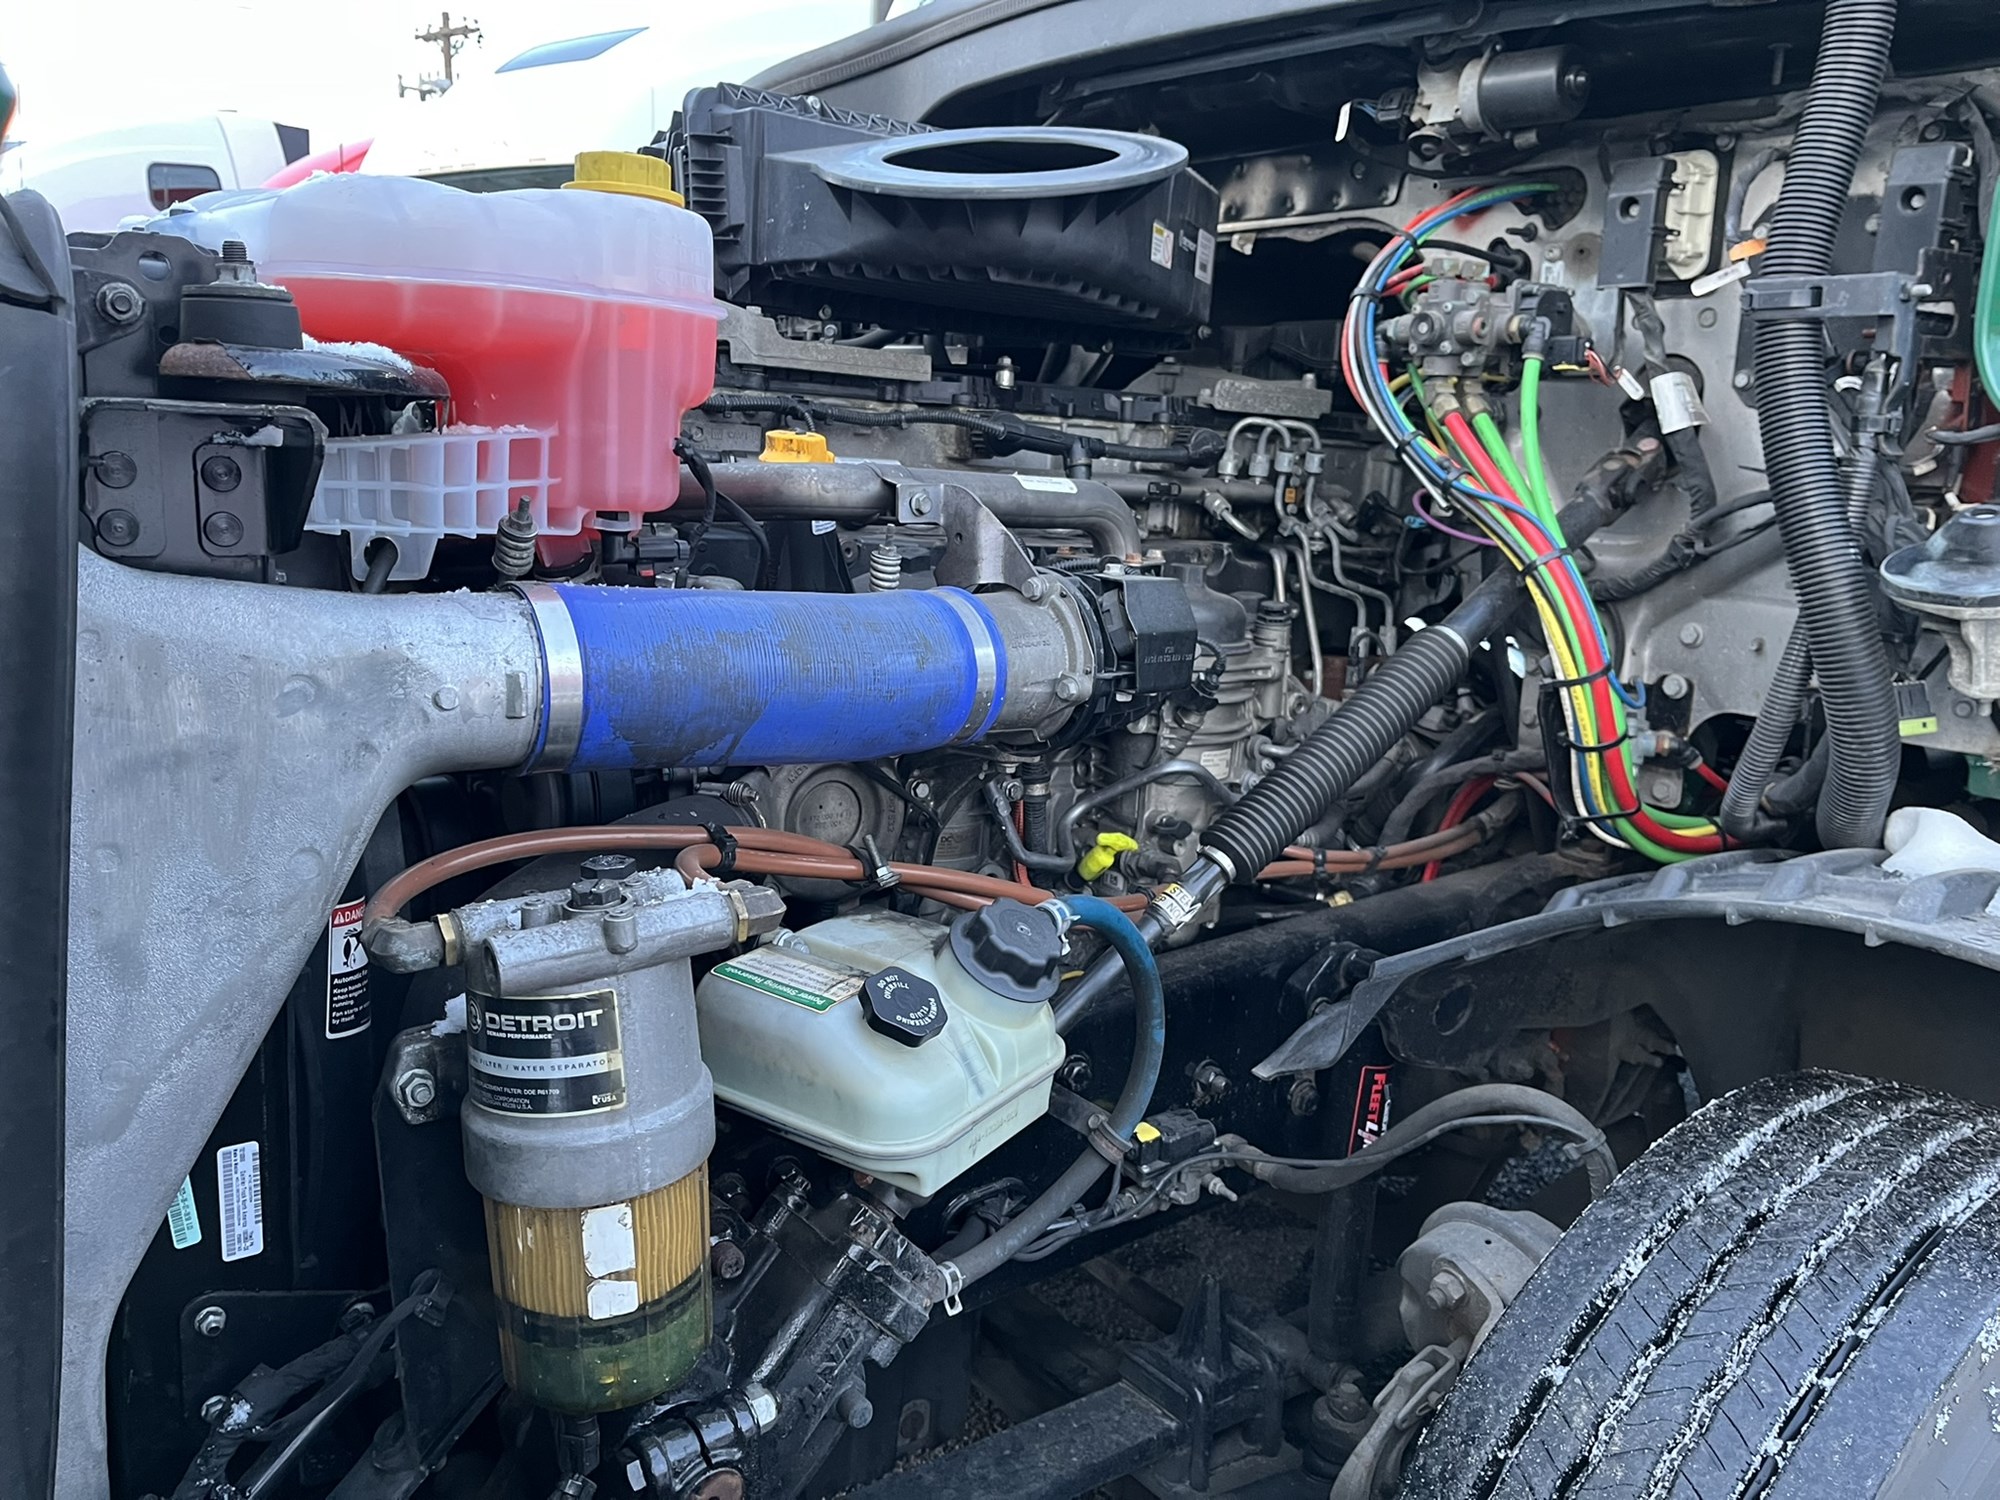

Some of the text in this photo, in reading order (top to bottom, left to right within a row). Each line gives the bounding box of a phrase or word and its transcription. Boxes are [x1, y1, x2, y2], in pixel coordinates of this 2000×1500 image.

[345, 904, 366, 923] DANG
[333, 973, 362, 985] Automatic
[724, 966, 764, 984] Reservoir
[876, 974, 899, 989] DO NOT
[762, 979, 799, 997] Steering
[883, 981, 910, 1000] OVERFILL
[800, 992, 826, 1006] Power
[895, 997, 938, 1026] POWER STEERING
[909, 1005, 929, 1019] FLUID
[485, 1009, 604, 1032] DETROIT
[486, 1030, 554, 1040] DEMAND PERFORMANCE
[479, 1059, 503, 1071] FILTER
[513, 1064, 546, 1072] WATER
[550, 1057, 614, 1072] SEPARATOR
[493, 1094, 531, 1105] CORPORATION
